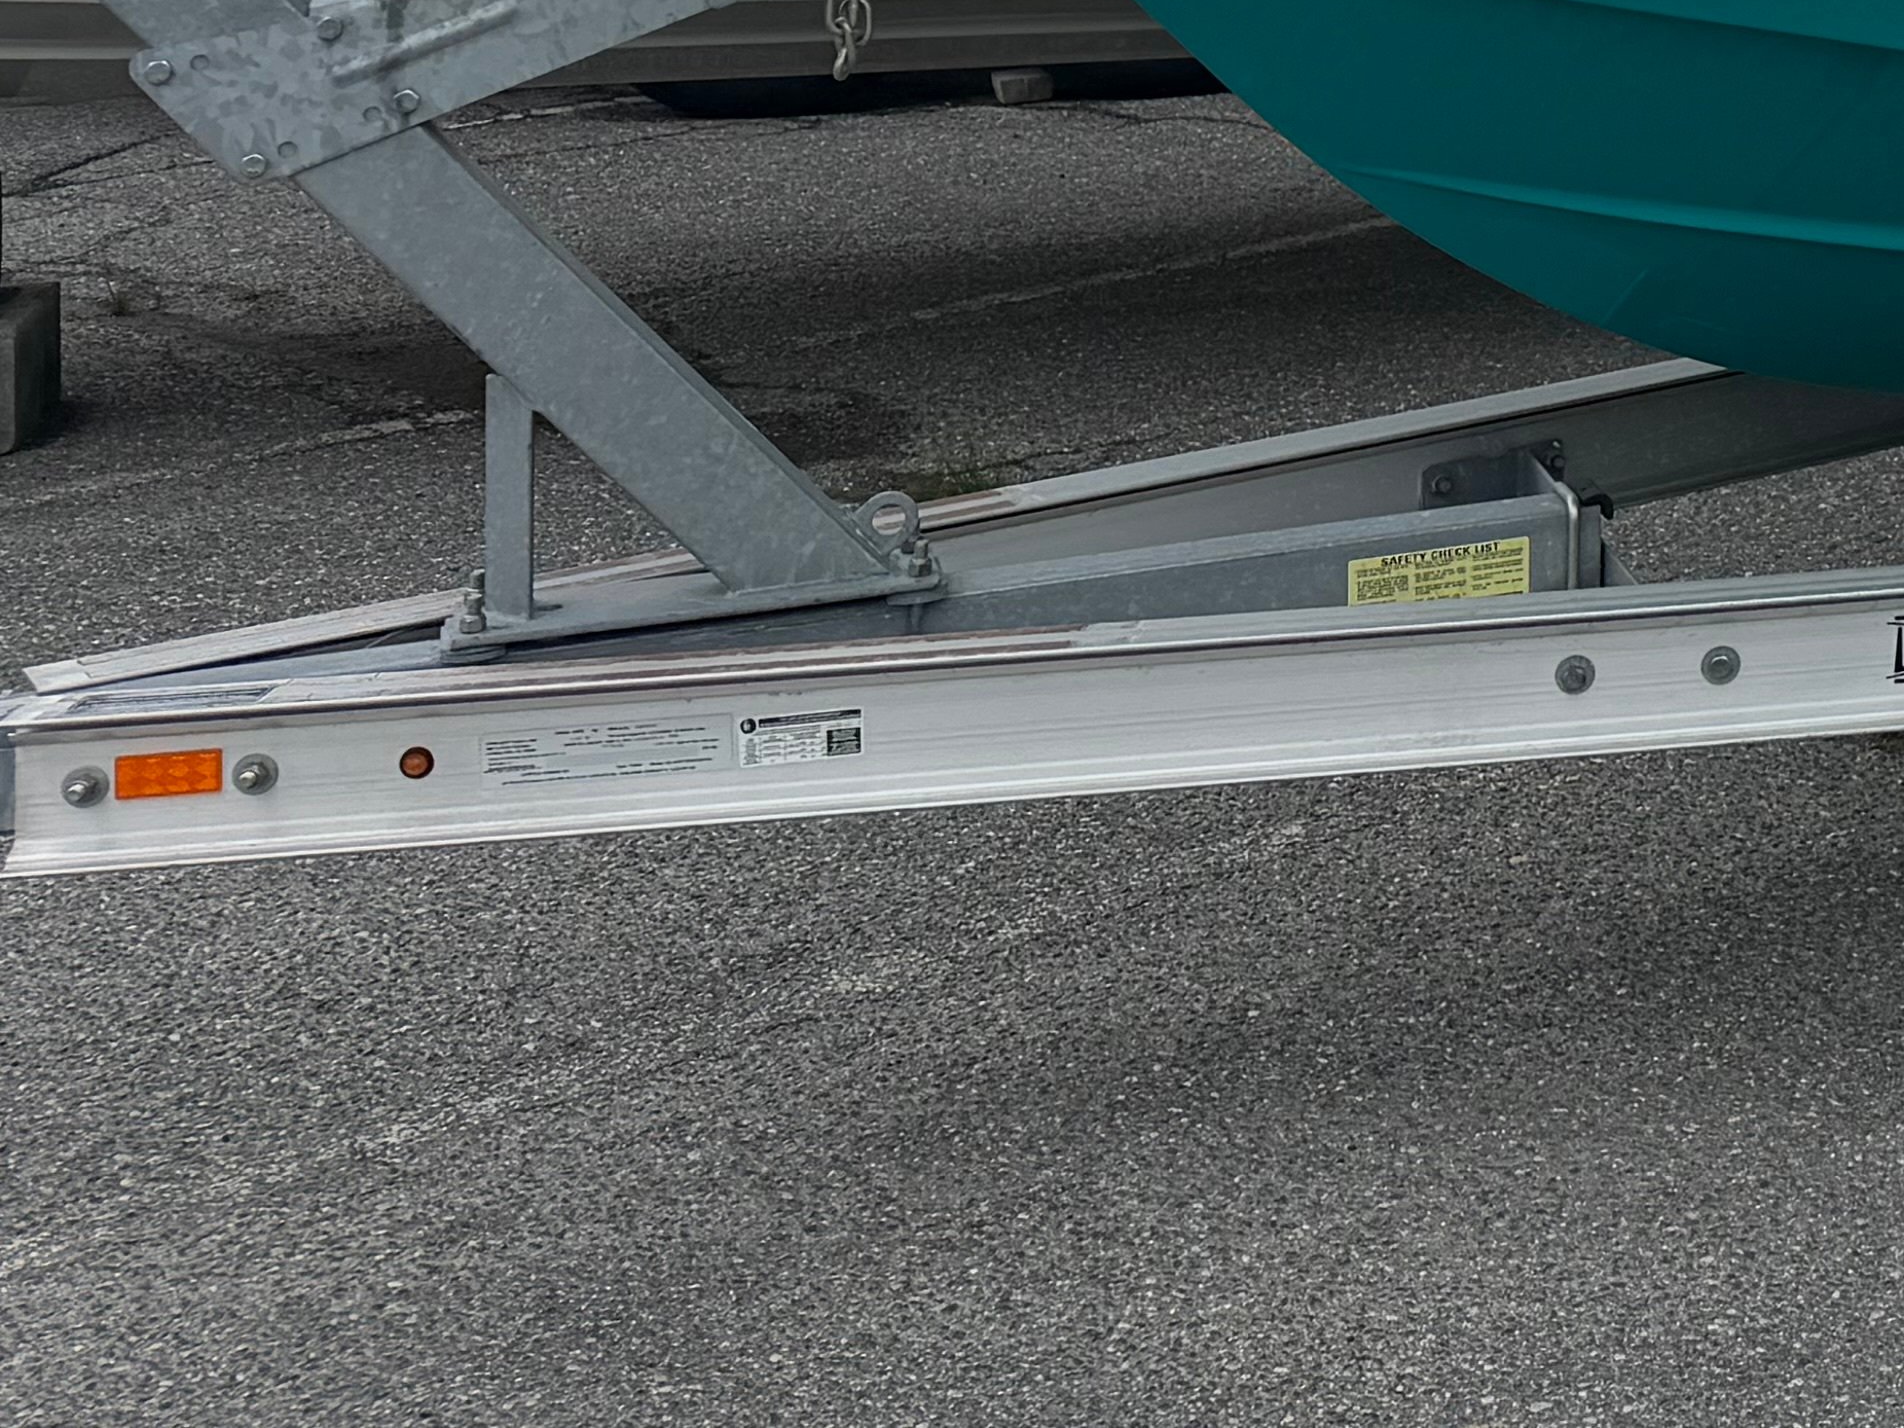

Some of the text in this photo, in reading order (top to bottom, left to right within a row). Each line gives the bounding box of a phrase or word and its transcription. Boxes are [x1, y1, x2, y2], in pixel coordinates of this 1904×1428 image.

[1380, 541, 1500, 568] SAFETY CHECK LIST
